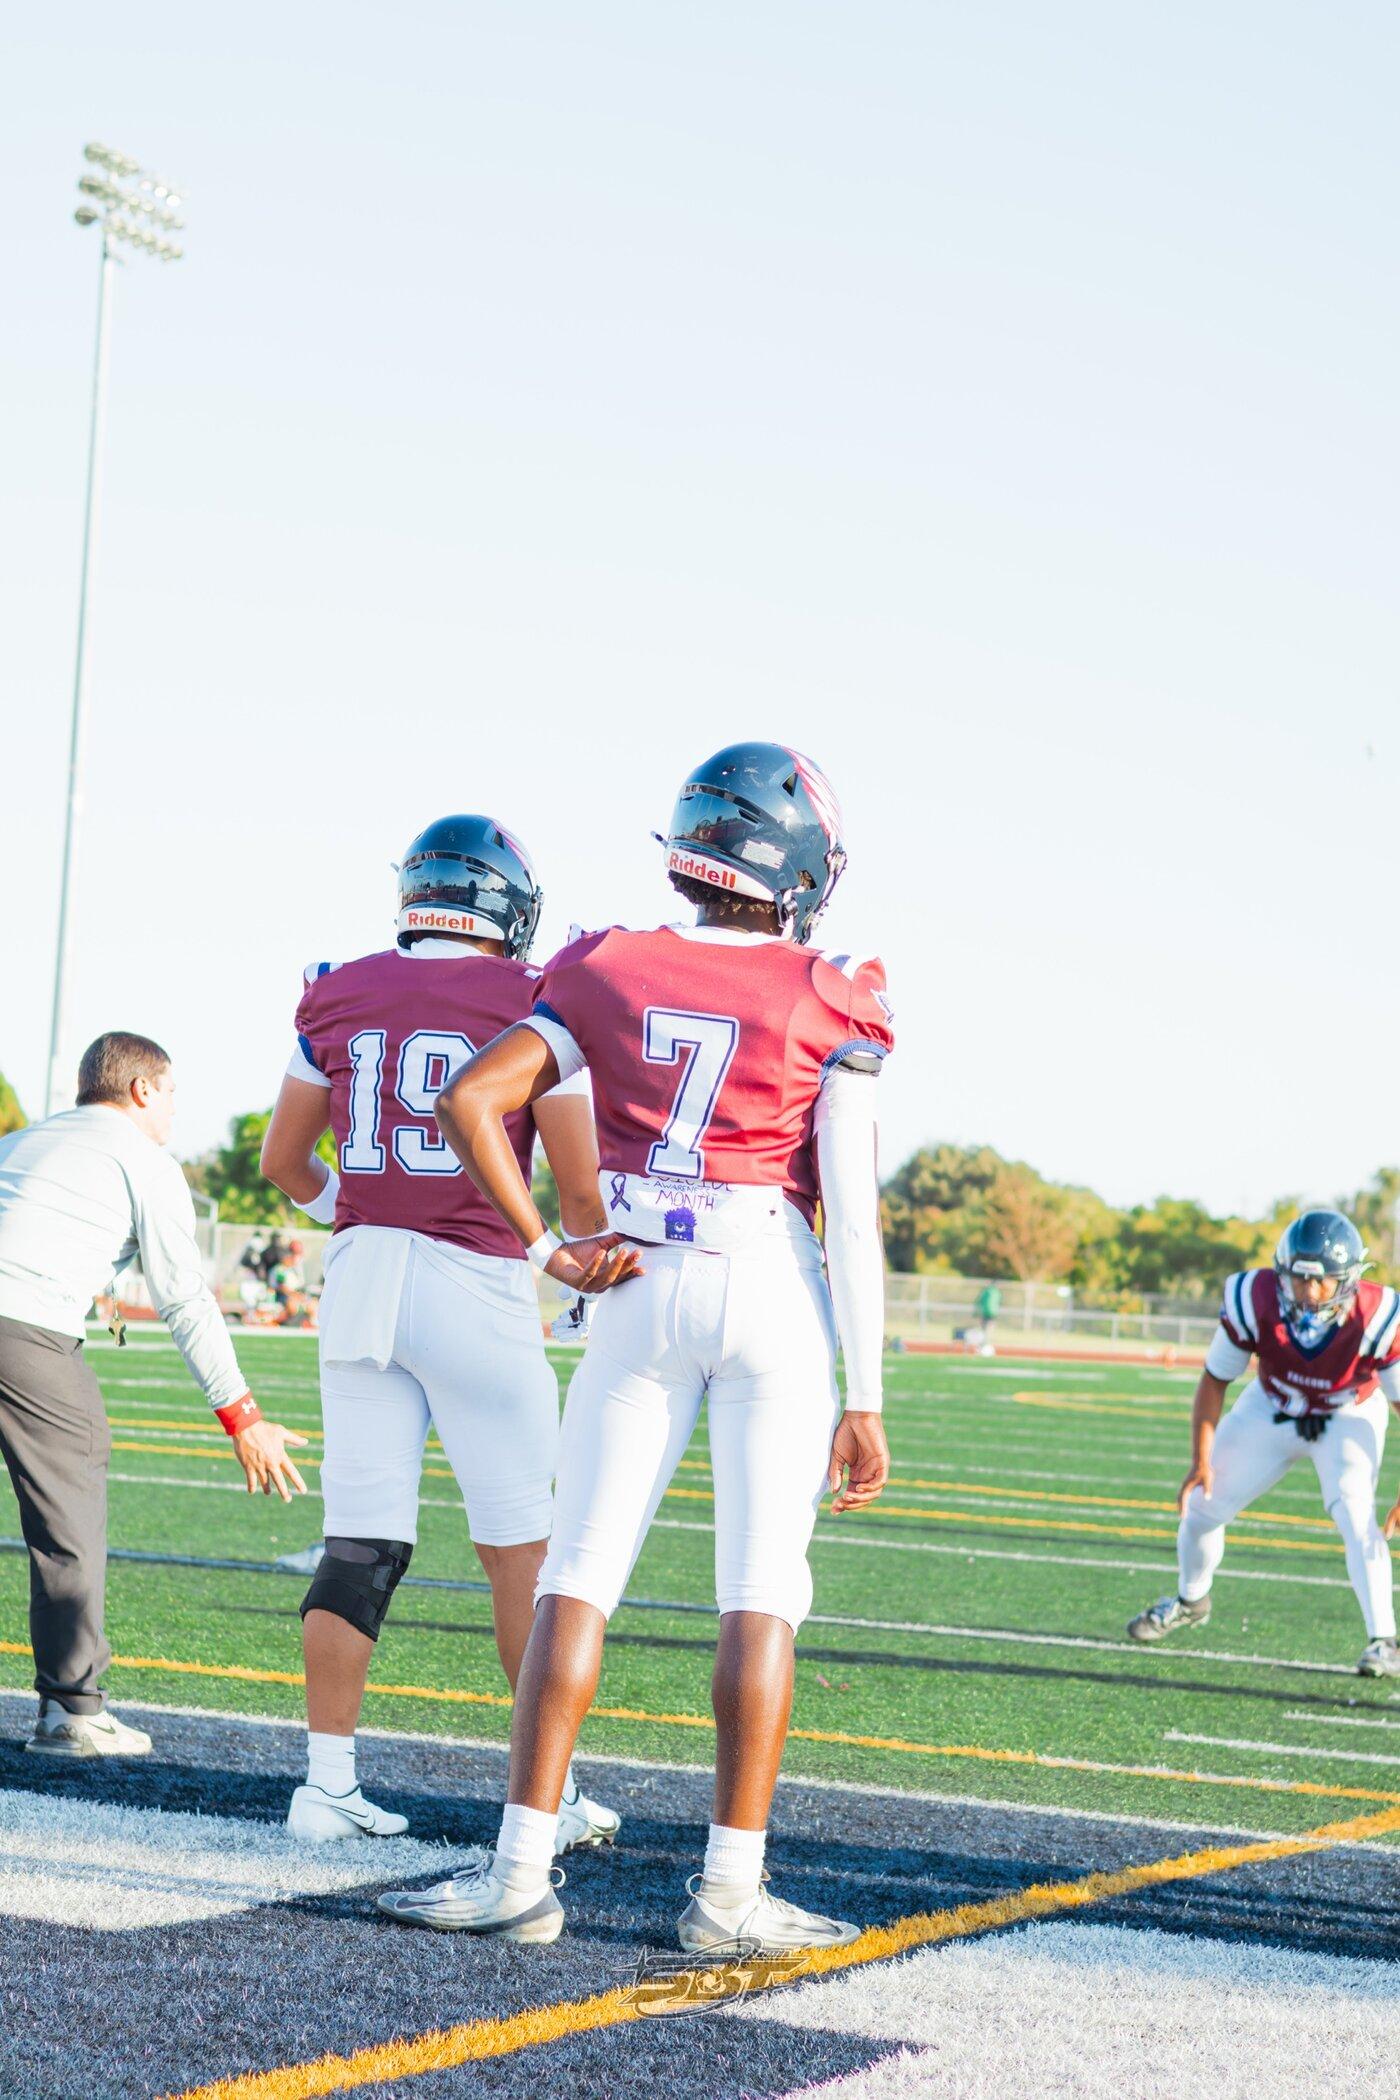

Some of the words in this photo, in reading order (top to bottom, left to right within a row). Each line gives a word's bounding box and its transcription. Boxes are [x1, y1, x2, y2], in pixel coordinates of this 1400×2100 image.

[669, 852, 737, 888] Riddell
[408, 912, 475, 931] Riddell
[342, 1029, 479, 1176] 19
[642, 1006, 740, 1180] 7
[655, 1189, 715, 1211] MONTH
